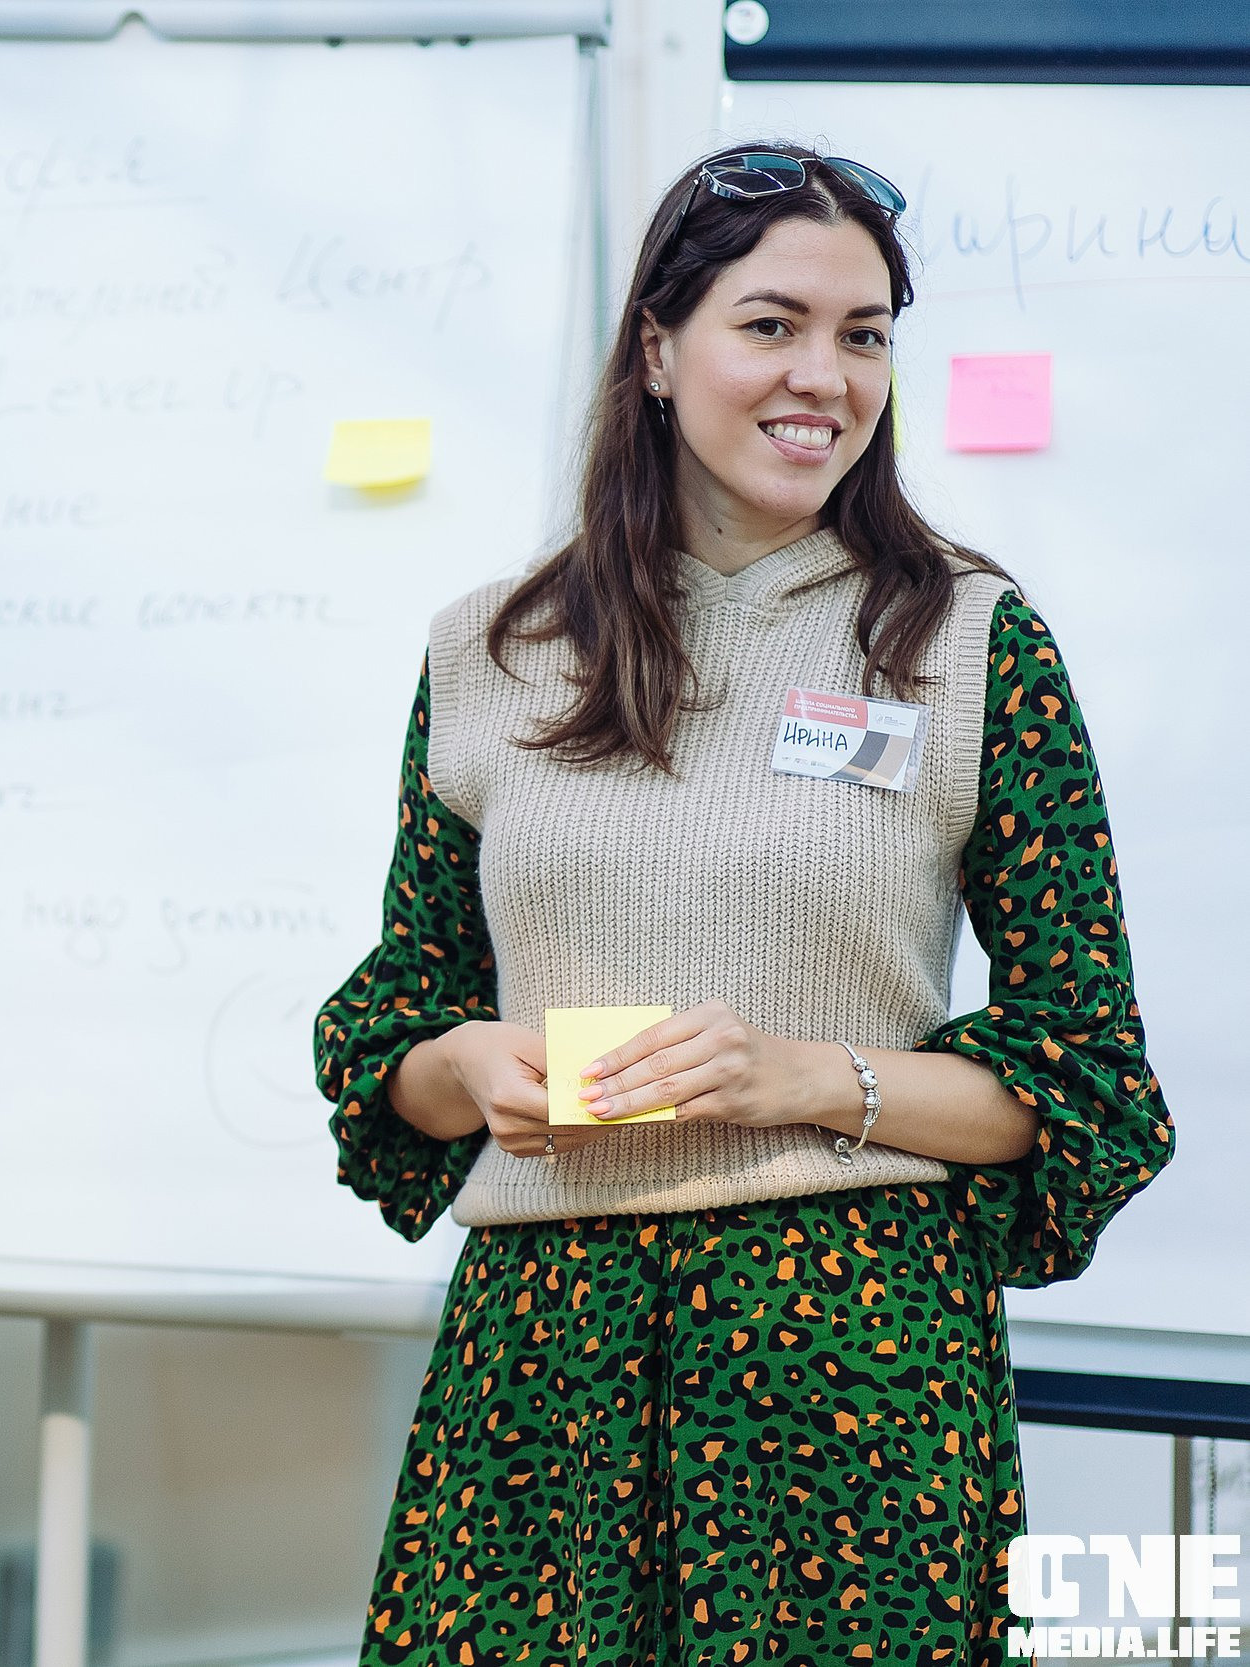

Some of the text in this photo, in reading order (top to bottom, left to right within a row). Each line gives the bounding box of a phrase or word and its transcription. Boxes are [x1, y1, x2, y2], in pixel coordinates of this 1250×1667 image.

[275, 231, 493, 334] Центр
[783, 722, 848, 751] ИРИНА
[21, 889, 128, 968] надо
